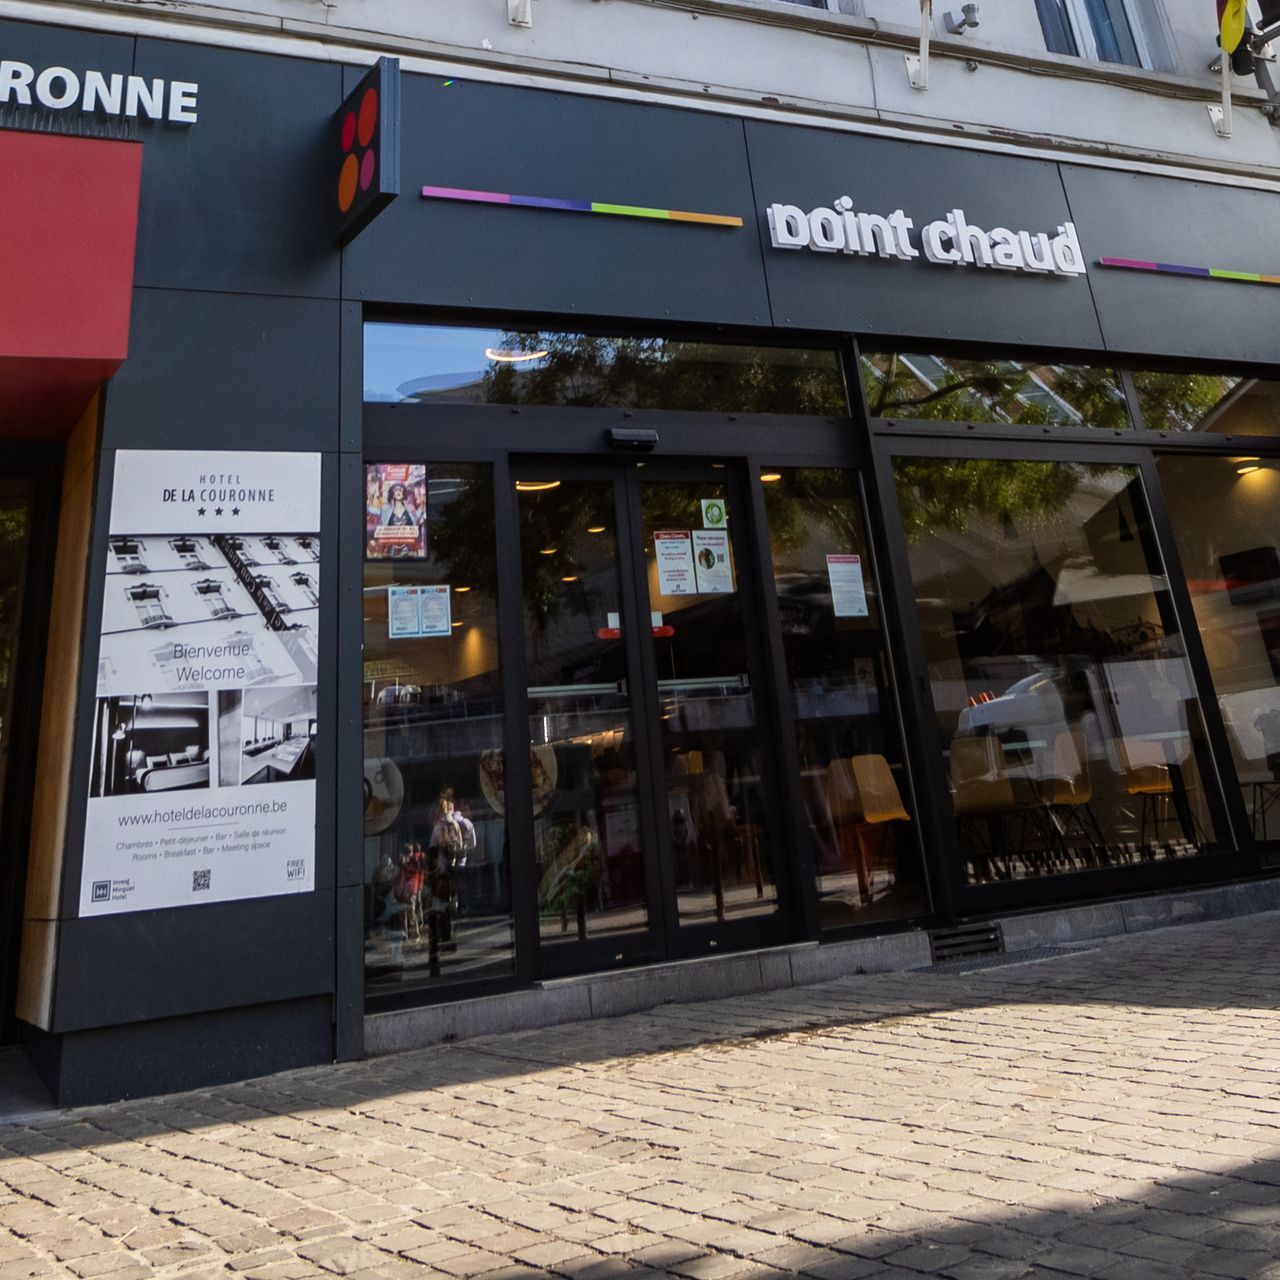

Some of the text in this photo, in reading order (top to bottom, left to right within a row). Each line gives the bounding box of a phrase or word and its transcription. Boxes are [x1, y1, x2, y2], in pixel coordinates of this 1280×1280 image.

[921, 208, 1087, 277] chaud
[199, 474, 241, 484] HOTEL
[163, 488, 275, 503] DE LA COURONNE
[173, 643, 250, 660] Bienvenue
[176, 664, 245, 682] Welcome
[118, 800, 288, 827] www.hoteldelacouronne.be
[286, 859, 305, 868] FREE
[286, 868, 306, 879] WIFI
